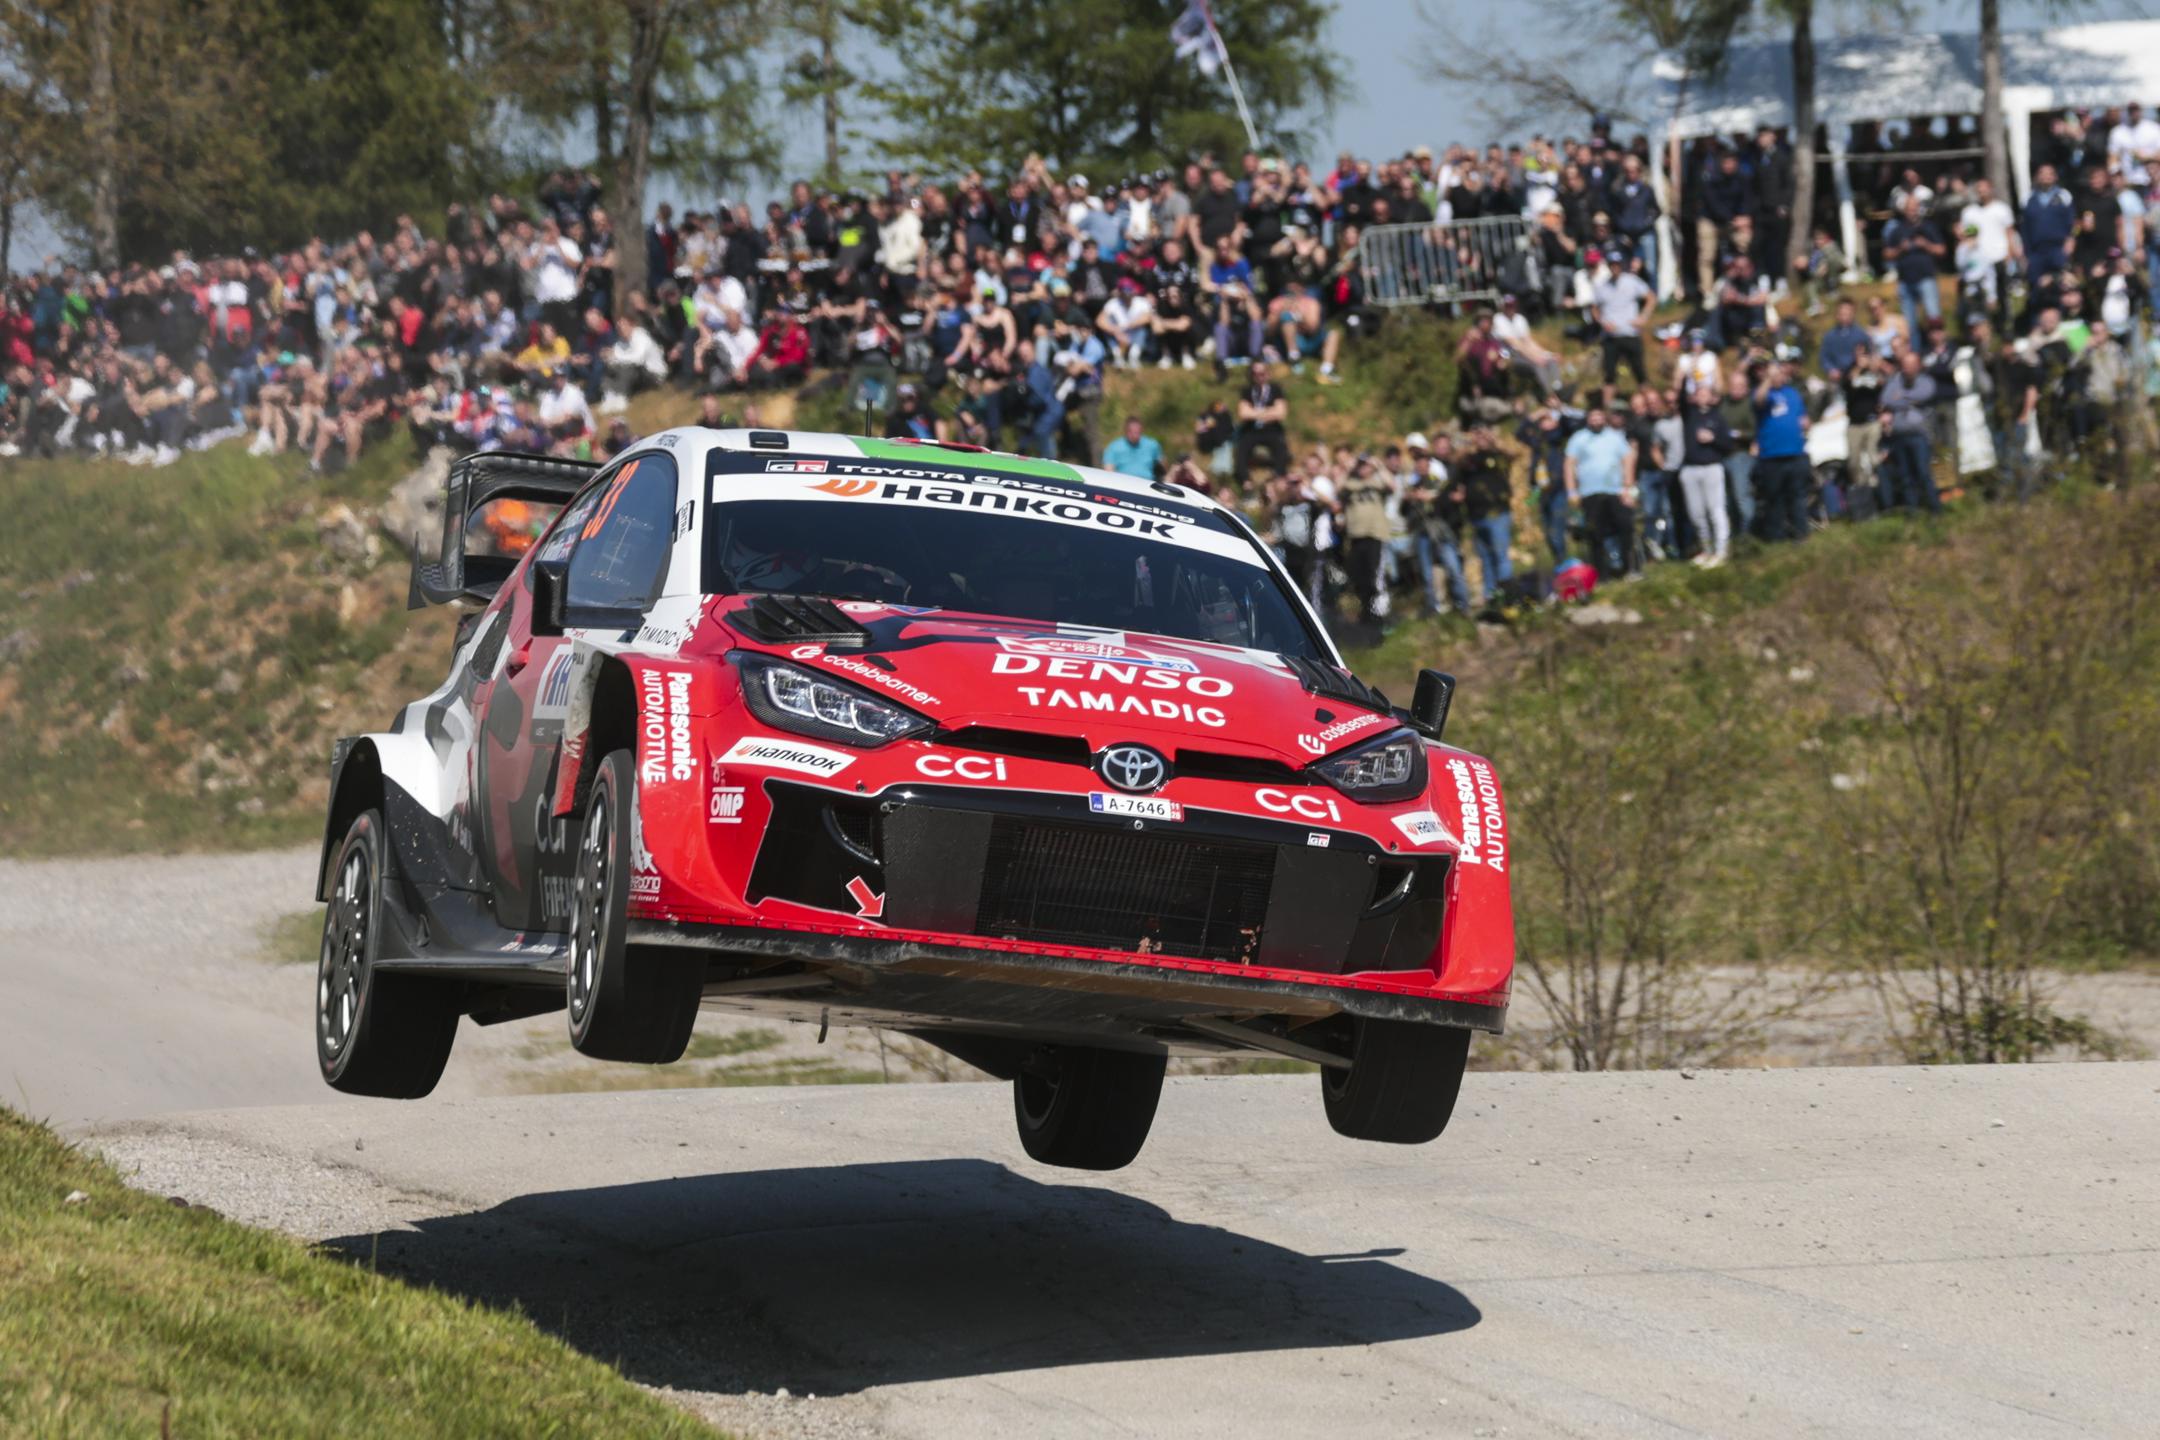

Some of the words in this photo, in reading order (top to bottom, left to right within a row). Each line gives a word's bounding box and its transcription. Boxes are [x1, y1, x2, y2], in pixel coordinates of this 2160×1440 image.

[767, 461, 828, 472] GR
[837, 464, 965, 481] TOYOTA
[974, 475, 1087, 498] GAZOO
[823, 654, 938, 705] codebeamer
[991, 653, 1234, 698] DENSO
[641, 668, 666, 783] AUTOMOTIVE
[667, 671, 698, 780] Panasonic
[1017, 686, 1227, 727] TAMADIC
[710, 793, 744, 817] OMP
[1108, 798, 1165, 816] A-7646
[1445, 758, 1481, 864] Panasonic
[1470, 761, 1504, 872] AUTOMOTIVE
